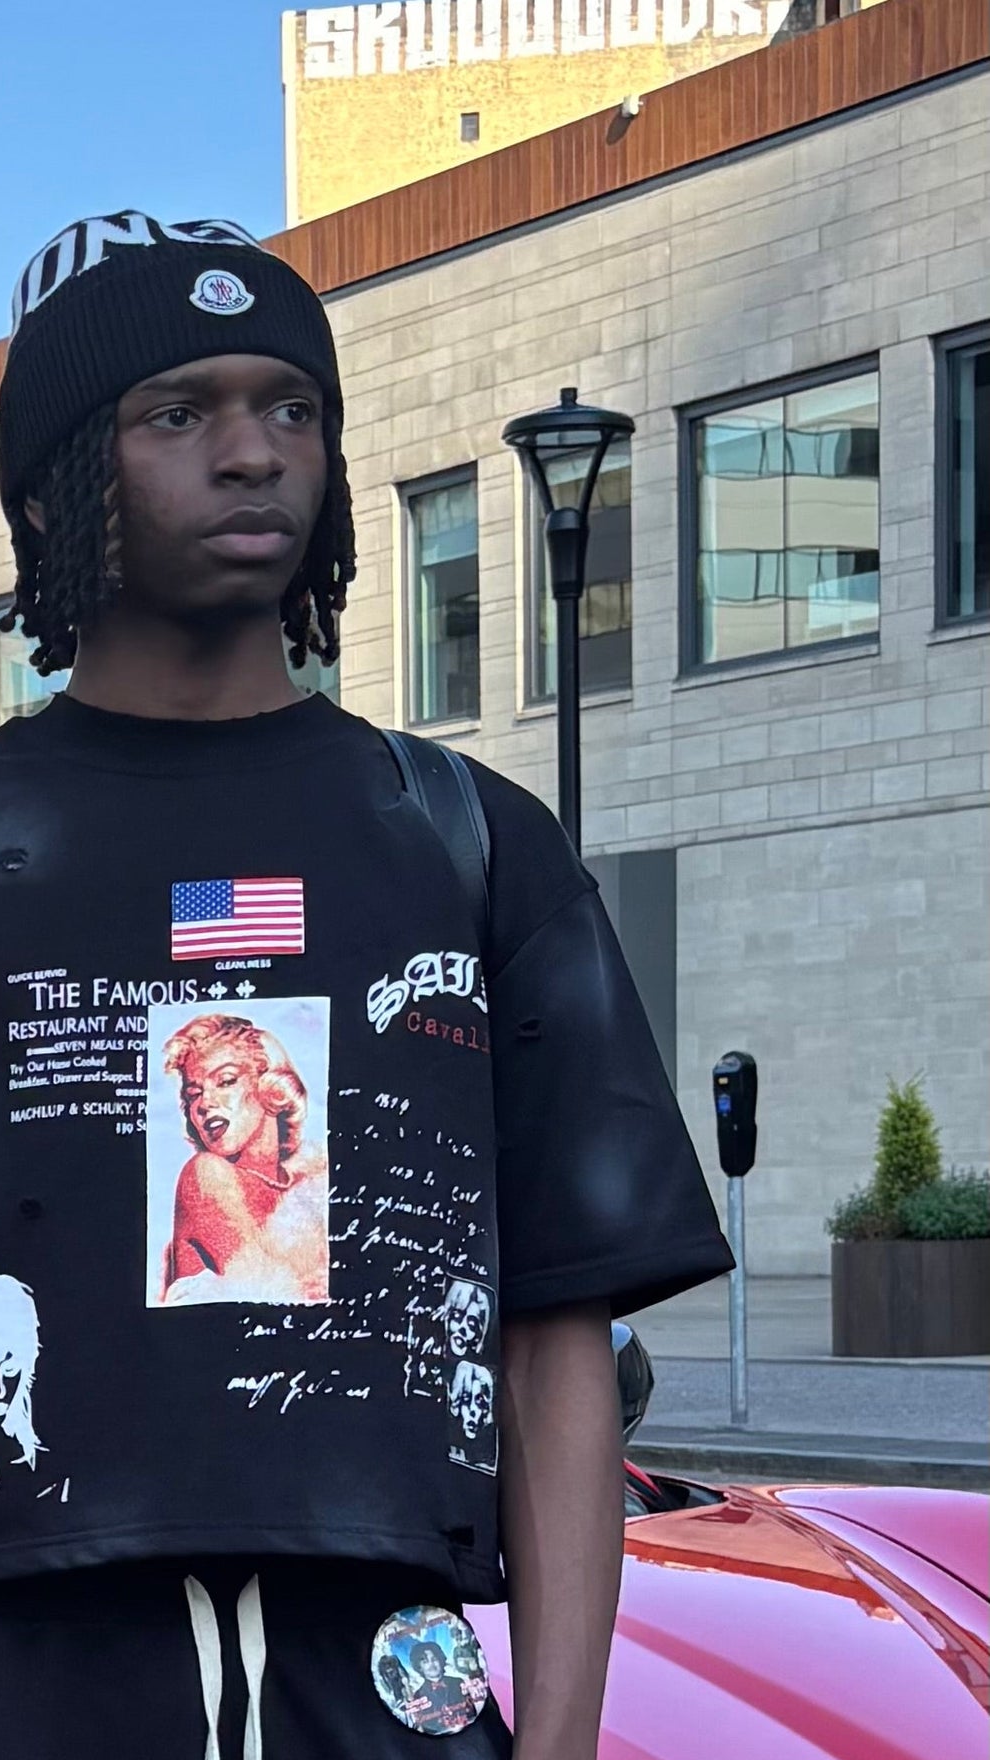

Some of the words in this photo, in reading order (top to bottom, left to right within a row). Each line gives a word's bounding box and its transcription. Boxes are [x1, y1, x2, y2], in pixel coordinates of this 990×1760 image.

[28, 982, 81, 1011] THE
[93, 978, 198, 1006] FAMOUS
[9, 1016, 109, 1041] RESTAURANT
[115, 1016, 148, 1033] AND
[54, 1040, 87, 1052] SEVEN
[90, 1040, 124, 1051] MEALS
[10, 1103, 65, 1123] MACHLUP
[68, 1103, 79, 1115] &
